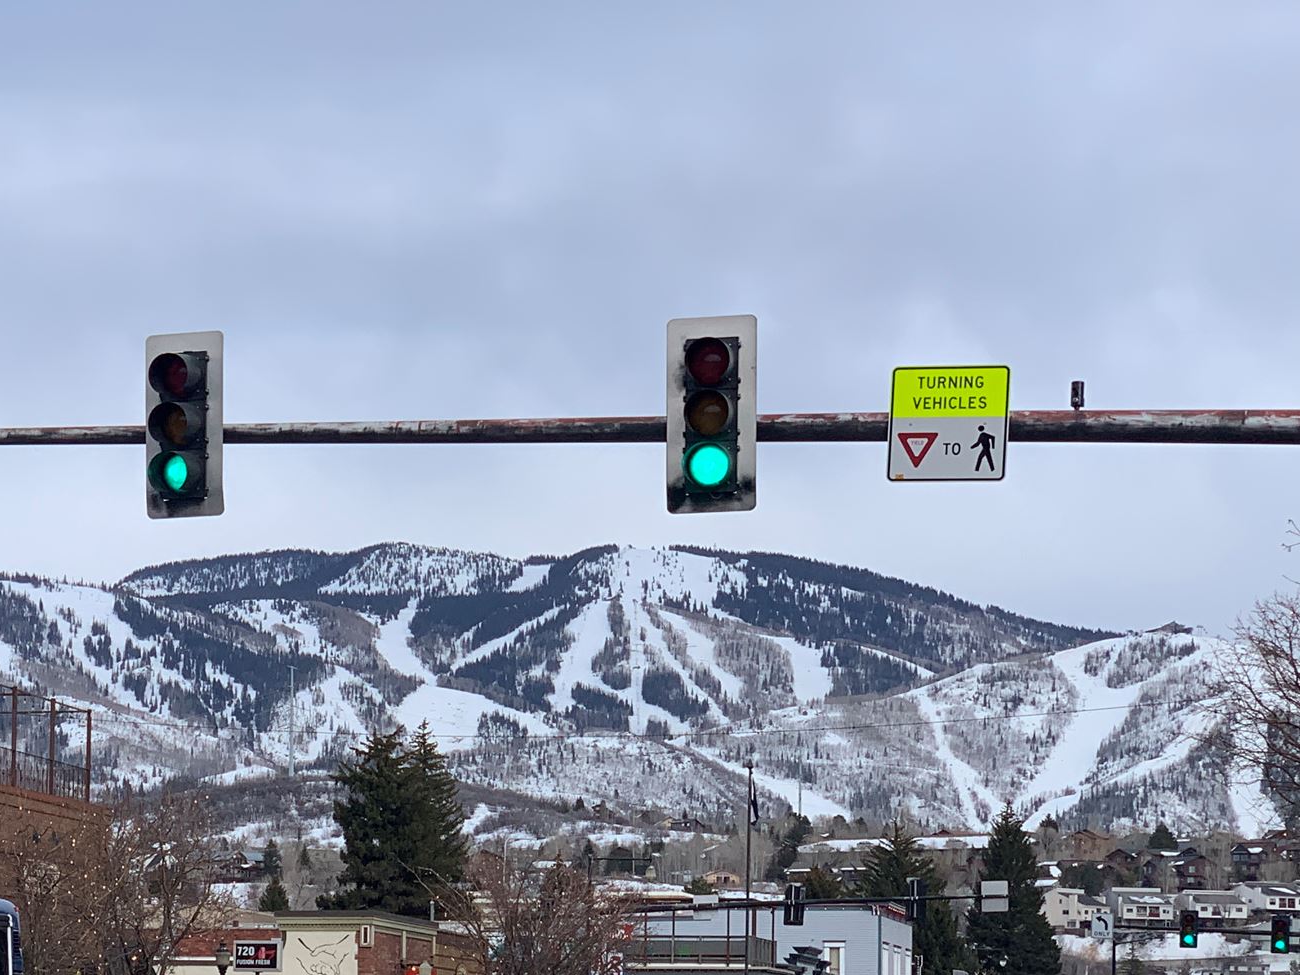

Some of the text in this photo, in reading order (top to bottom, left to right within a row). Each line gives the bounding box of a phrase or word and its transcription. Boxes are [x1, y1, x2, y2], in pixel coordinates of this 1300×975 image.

[917, 375, 985, 390] TURNING
[912, 396, 988, 410] VEHICLES
[943, 442, 962, 456] TO
[236, 945, 256, 956] 720
